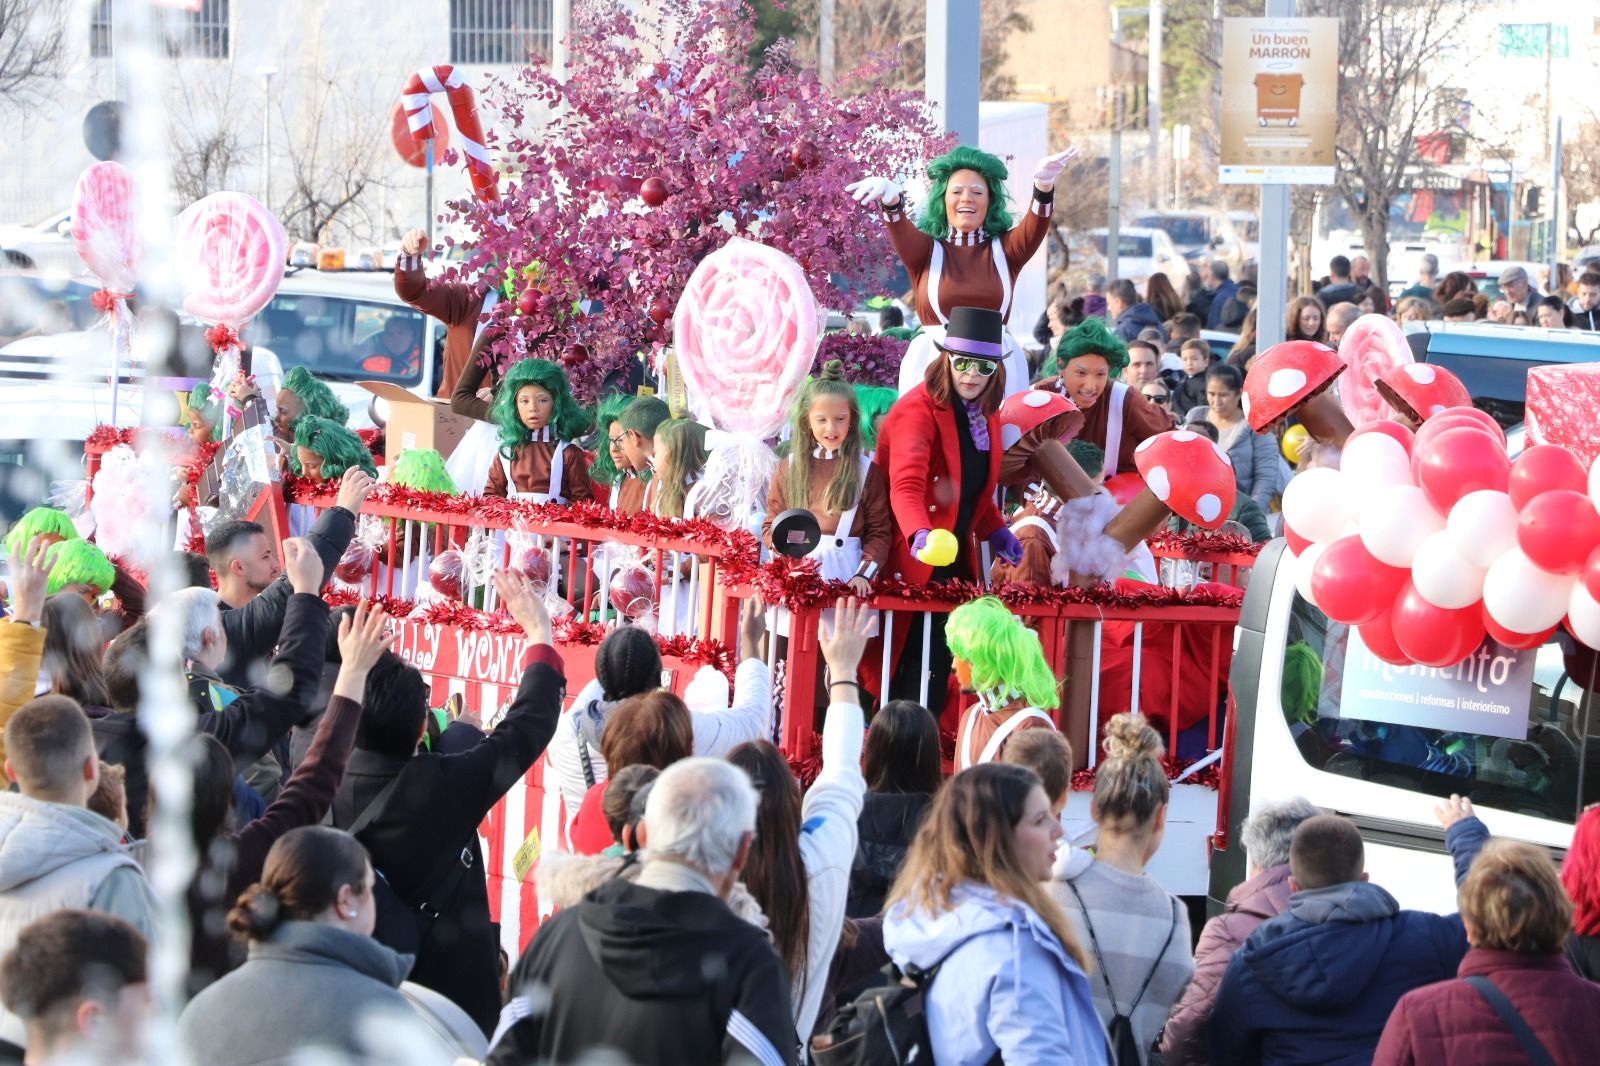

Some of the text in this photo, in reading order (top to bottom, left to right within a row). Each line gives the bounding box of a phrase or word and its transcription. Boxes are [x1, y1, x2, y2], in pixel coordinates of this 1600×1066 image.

[1252, 32, 1309, 45] Un buen
[1249, 45, 1311, 59] MARRÓN
[454, 629, 529, 685] WONK
[1420, 694, 1455, 708] reformas
[1461, 697, 1510, 715] interiorismo
